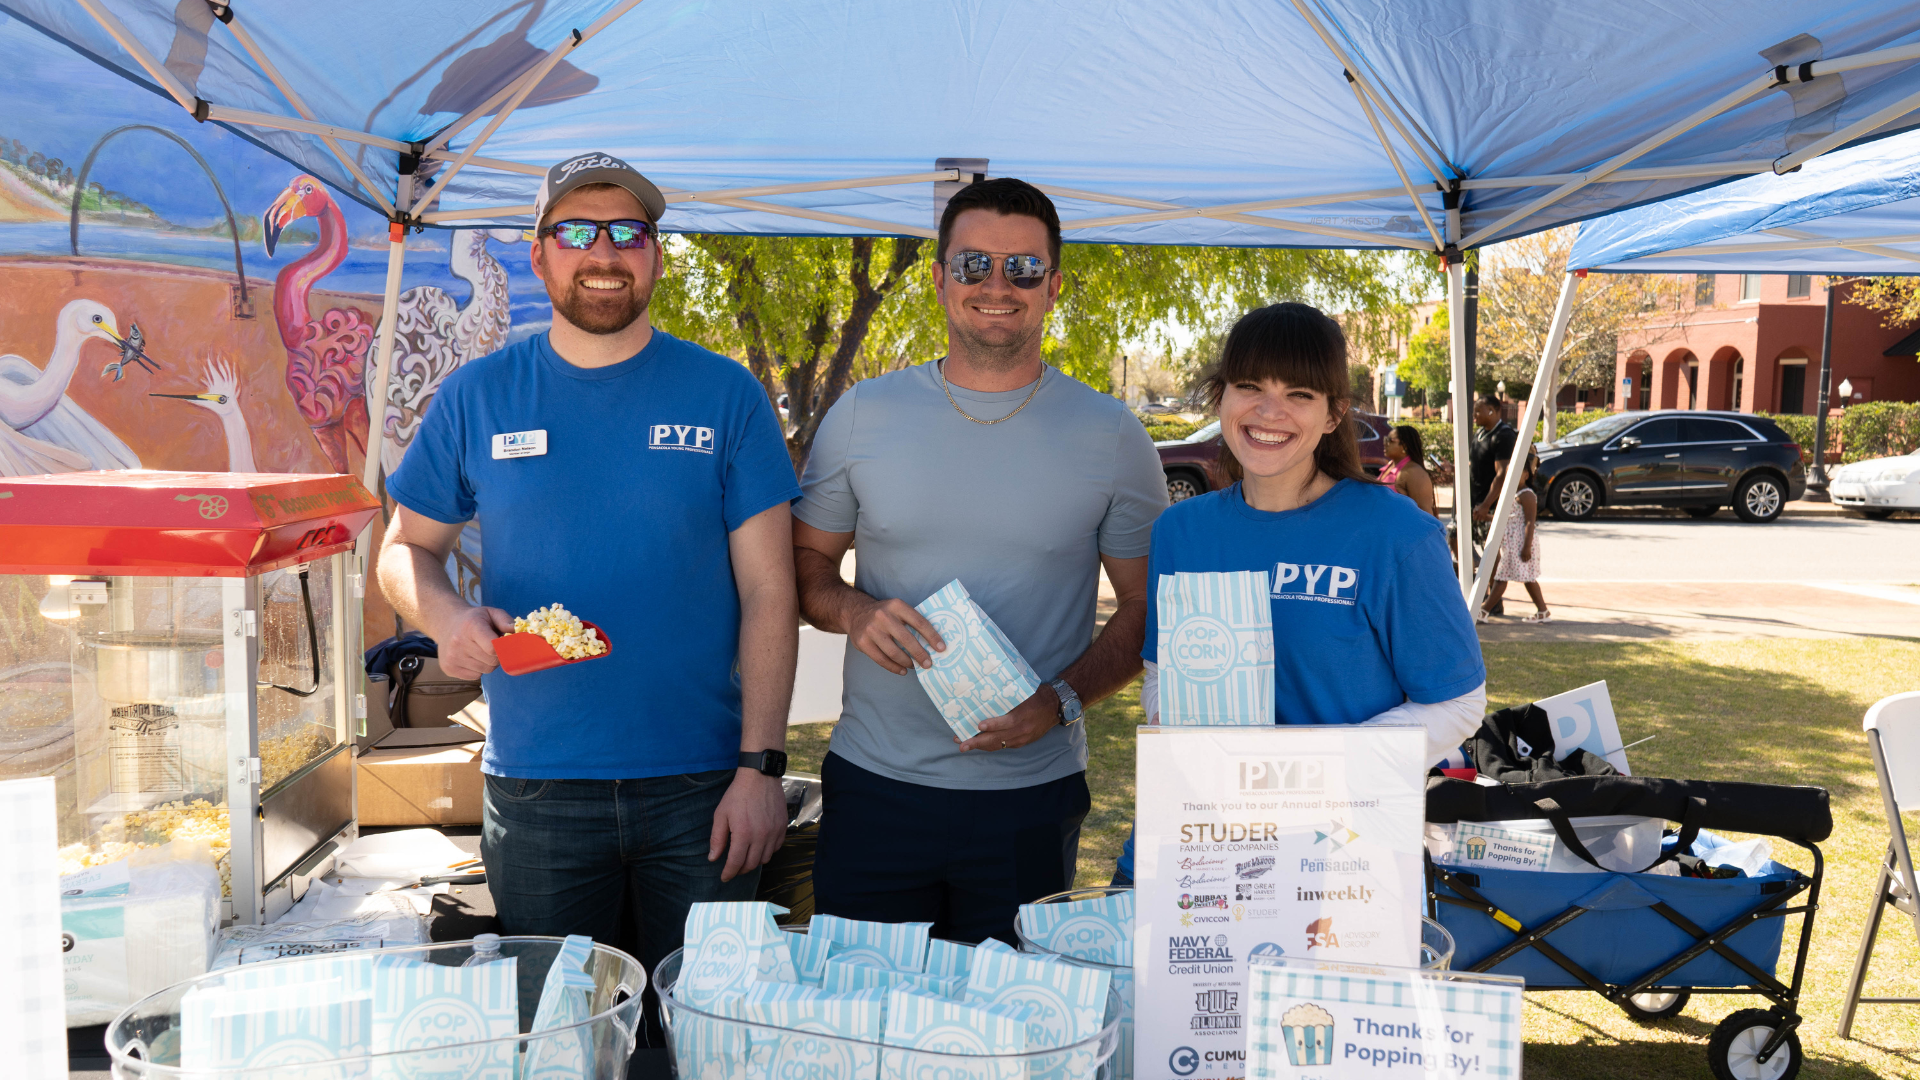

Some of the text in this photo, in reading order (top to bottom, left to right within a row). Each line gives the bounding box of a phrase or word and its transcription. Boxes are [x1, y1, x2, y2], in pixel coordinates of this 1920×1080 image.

[503, 432, 536, 446] PYP
[653, 424, 713, 448] PYP
[1272, 562, 1357, 598] PYP
[1295, 594, 1314, 602] YOUNG
[1314, 596, 1355, 606] PROFESSIONALS
[1184, 626, 1219, 642] POP
[1178, 643, 1227, 660] CORN
[1240, 760, 1324, 790] PYP
[1182, 798, 1380, 814] Thank you to our Annual Sponsors!
[1180, 822, 1279, 844] STUDER
[1180, 843, 1279, 852] FAMILY OF COMPANIES
[1493, 842, 1536, 856] Thanks for
[1300, 857, 1370, 873] Pensacola
[1487, 851, 1537, 866] Popping By!
[1194, 894, 1228, 903] BUBBA'S
[1296, 885, 1375, 904] inweekly
[1064, 928, 1105, 948] POP
[1169, 936, 1210, 948] NAVY
[1344, 931, 1381, 939] ADVISORY
[711, 940, 738, 960] POP
[1169, 947, 1233, 960] FEDERAL
[696, 961, 739, 979] CORN
[1169, 964, 1234, 975] Credit Union
[1195, 989, 1238, 1014] UWF
[419, 1012, 468, 1033] POP
[1190, 1015, 1242, 1030] ALUMNI
[1353, 1017, 1475, 1044] Thanks for
[791, 1038, 831, 1059] POP
[1204, 1050, 1246, 1062] CUMU
[1344, 1043, 1480, 1076] Popping By!
[781, 1060, 839, 1080] CORN
